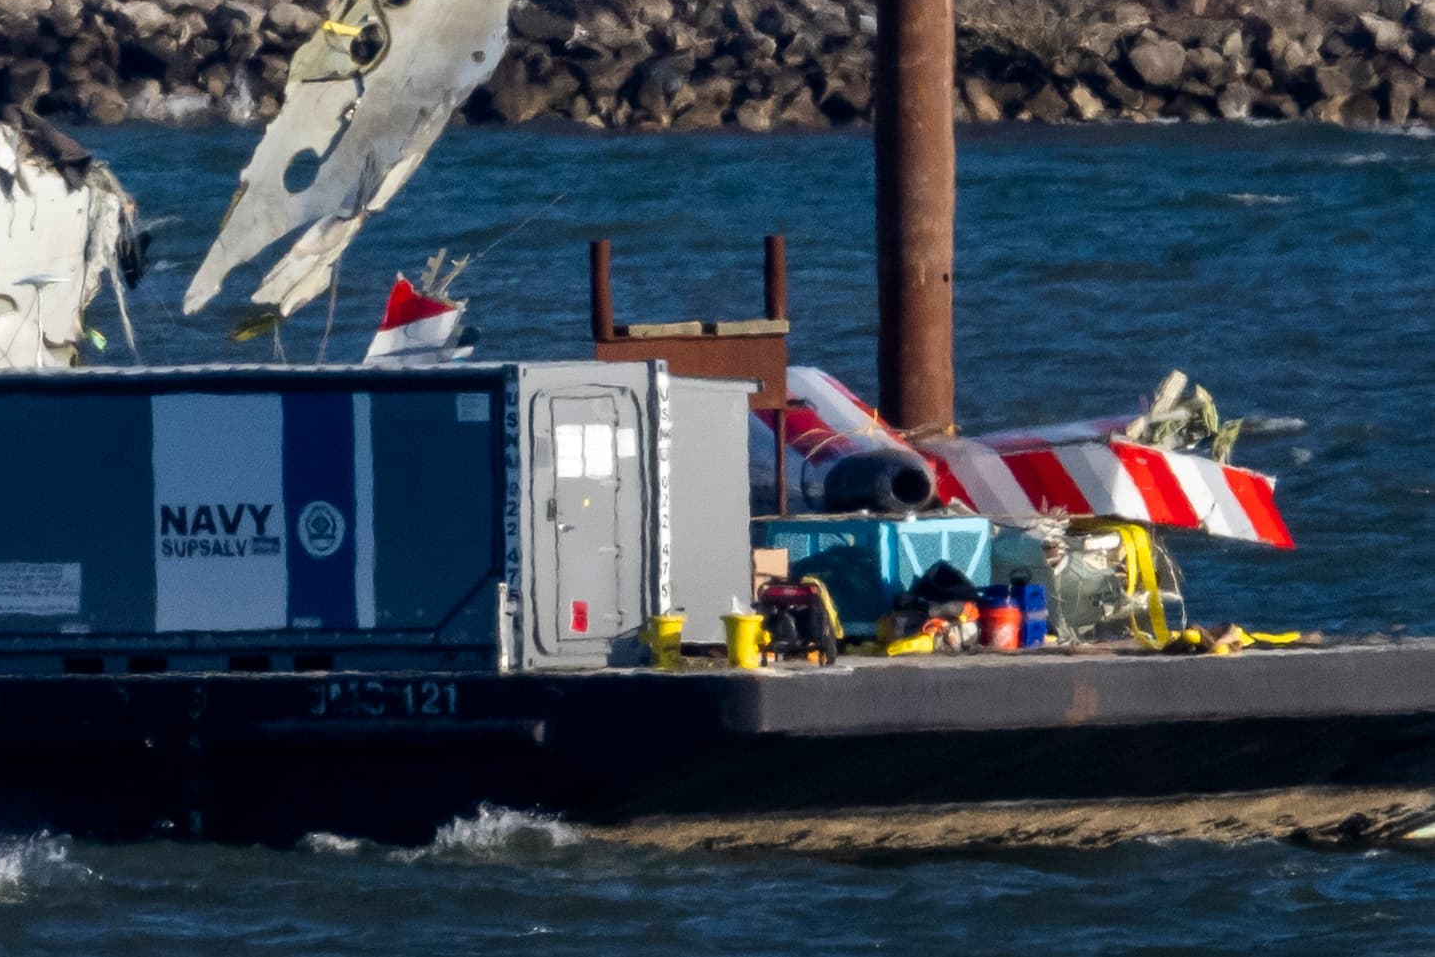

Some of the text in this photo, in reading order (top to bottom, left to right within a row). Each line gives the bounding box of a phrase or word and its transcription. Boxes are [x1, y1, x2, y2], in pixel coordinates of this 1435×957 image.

[160, 503, 274, 537] NAVY
[161, 538, 247, 558] SUPSALV
[401, 680, 458, 716] 121
